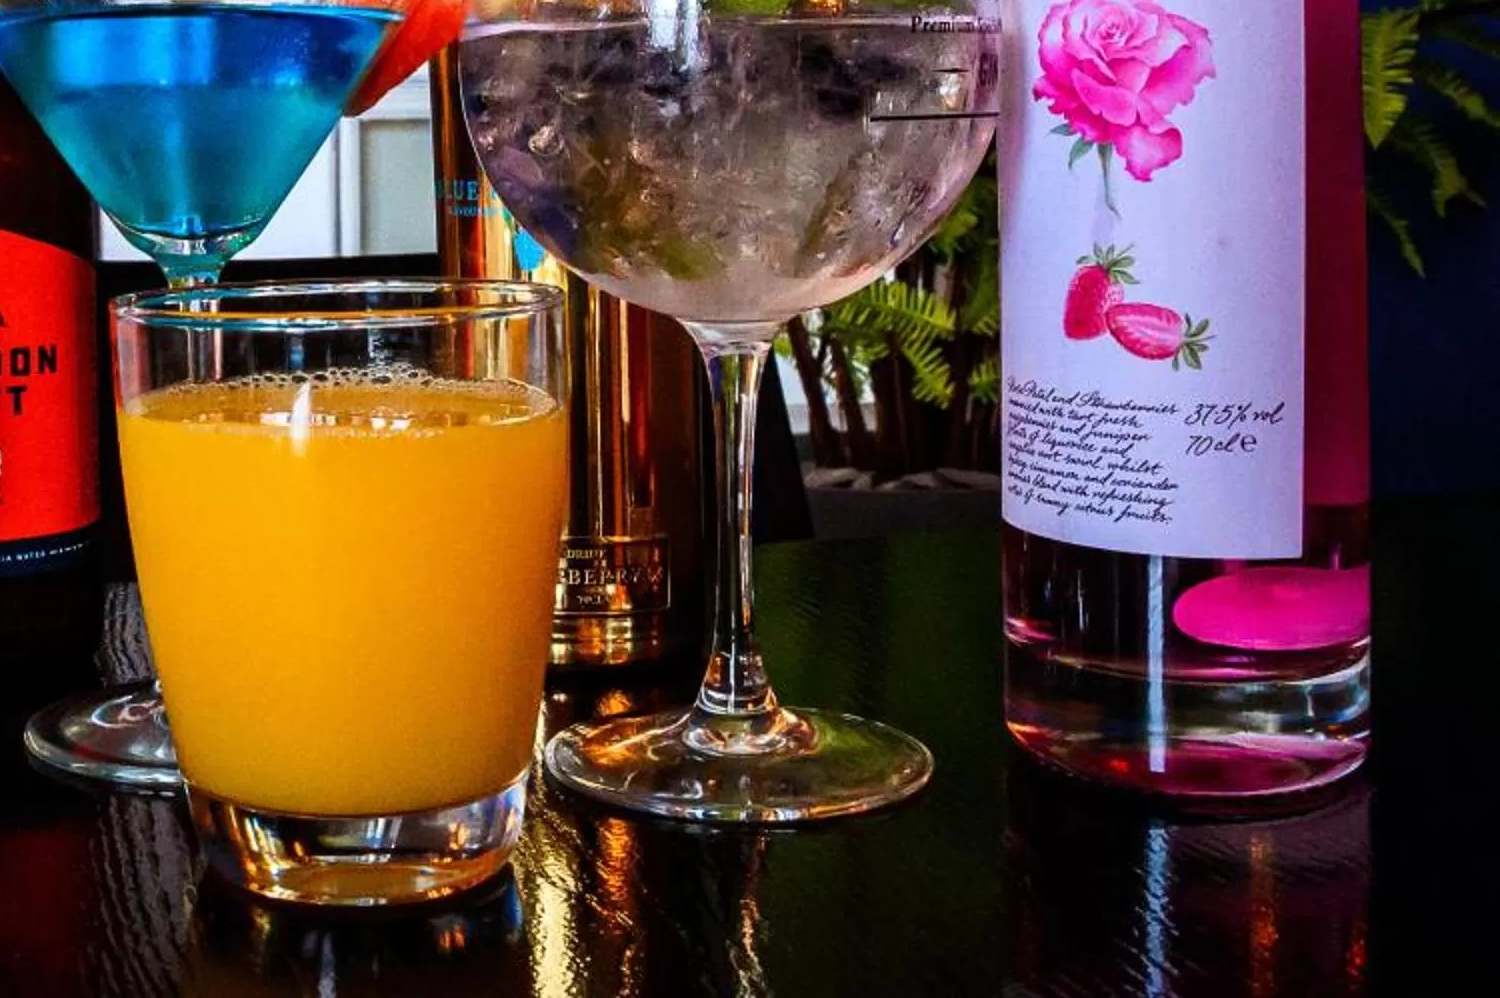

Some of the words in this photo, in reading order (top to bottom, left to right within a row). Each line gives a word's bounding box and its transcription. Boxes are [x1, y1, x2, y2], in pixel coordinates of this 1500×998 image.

[1252, 401, 1285, 424] vol
[1060, 422, 1087, 436] and
[1100, 442, 1135, 458] and
[1108, 457, 1164, 476] whilst
[1084, 471, 1114, 486] and
